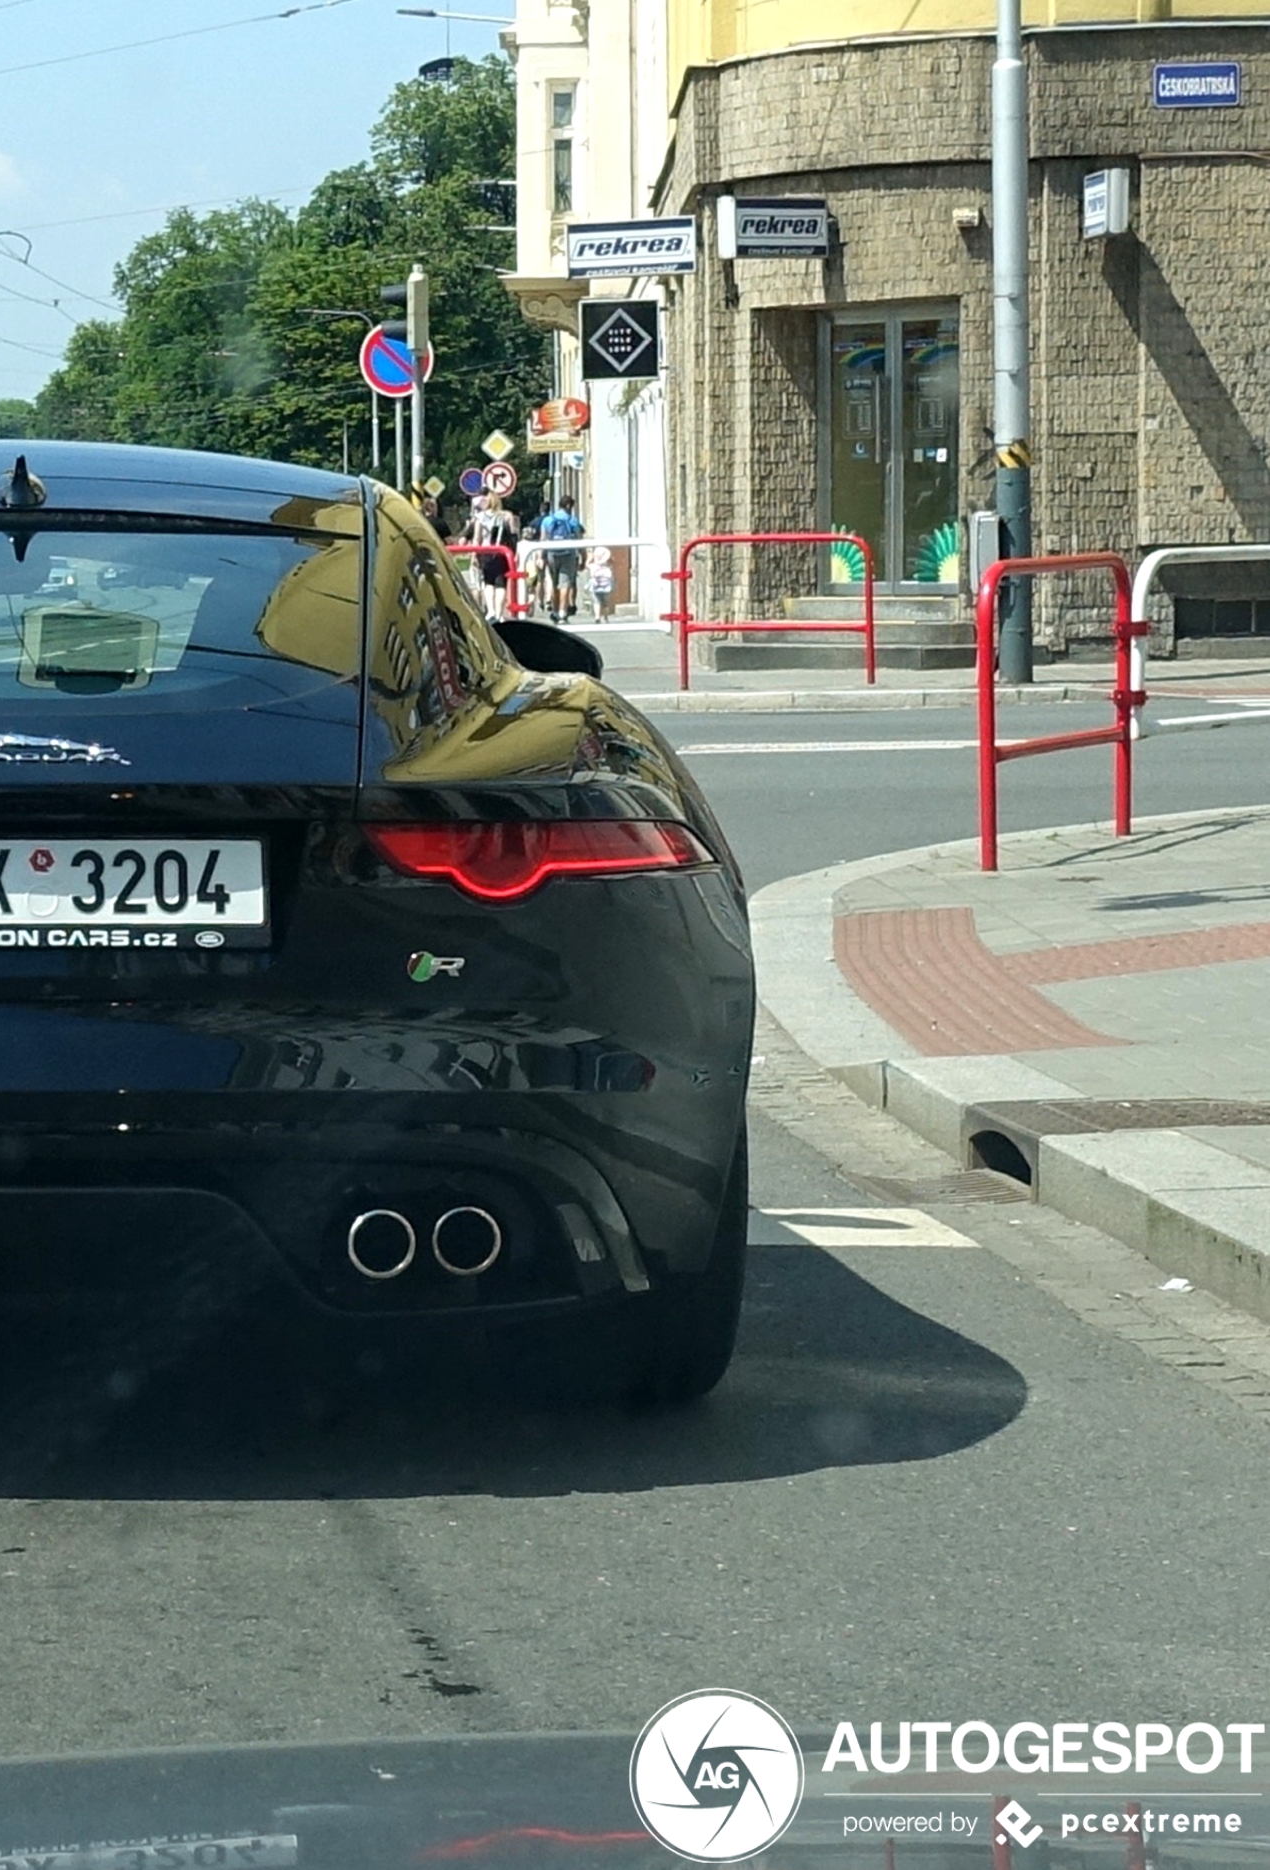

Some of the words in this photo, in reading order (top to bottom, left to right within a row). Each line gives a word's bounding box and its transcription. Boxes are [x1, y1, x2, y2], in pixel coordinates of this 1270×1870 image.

[741, 215, 820, 235] rekrea
[576, 237, 684, 257] rekrea
[70, 849, 231, 914] 3204
[47, 929, 178, 947] CARS.cz
